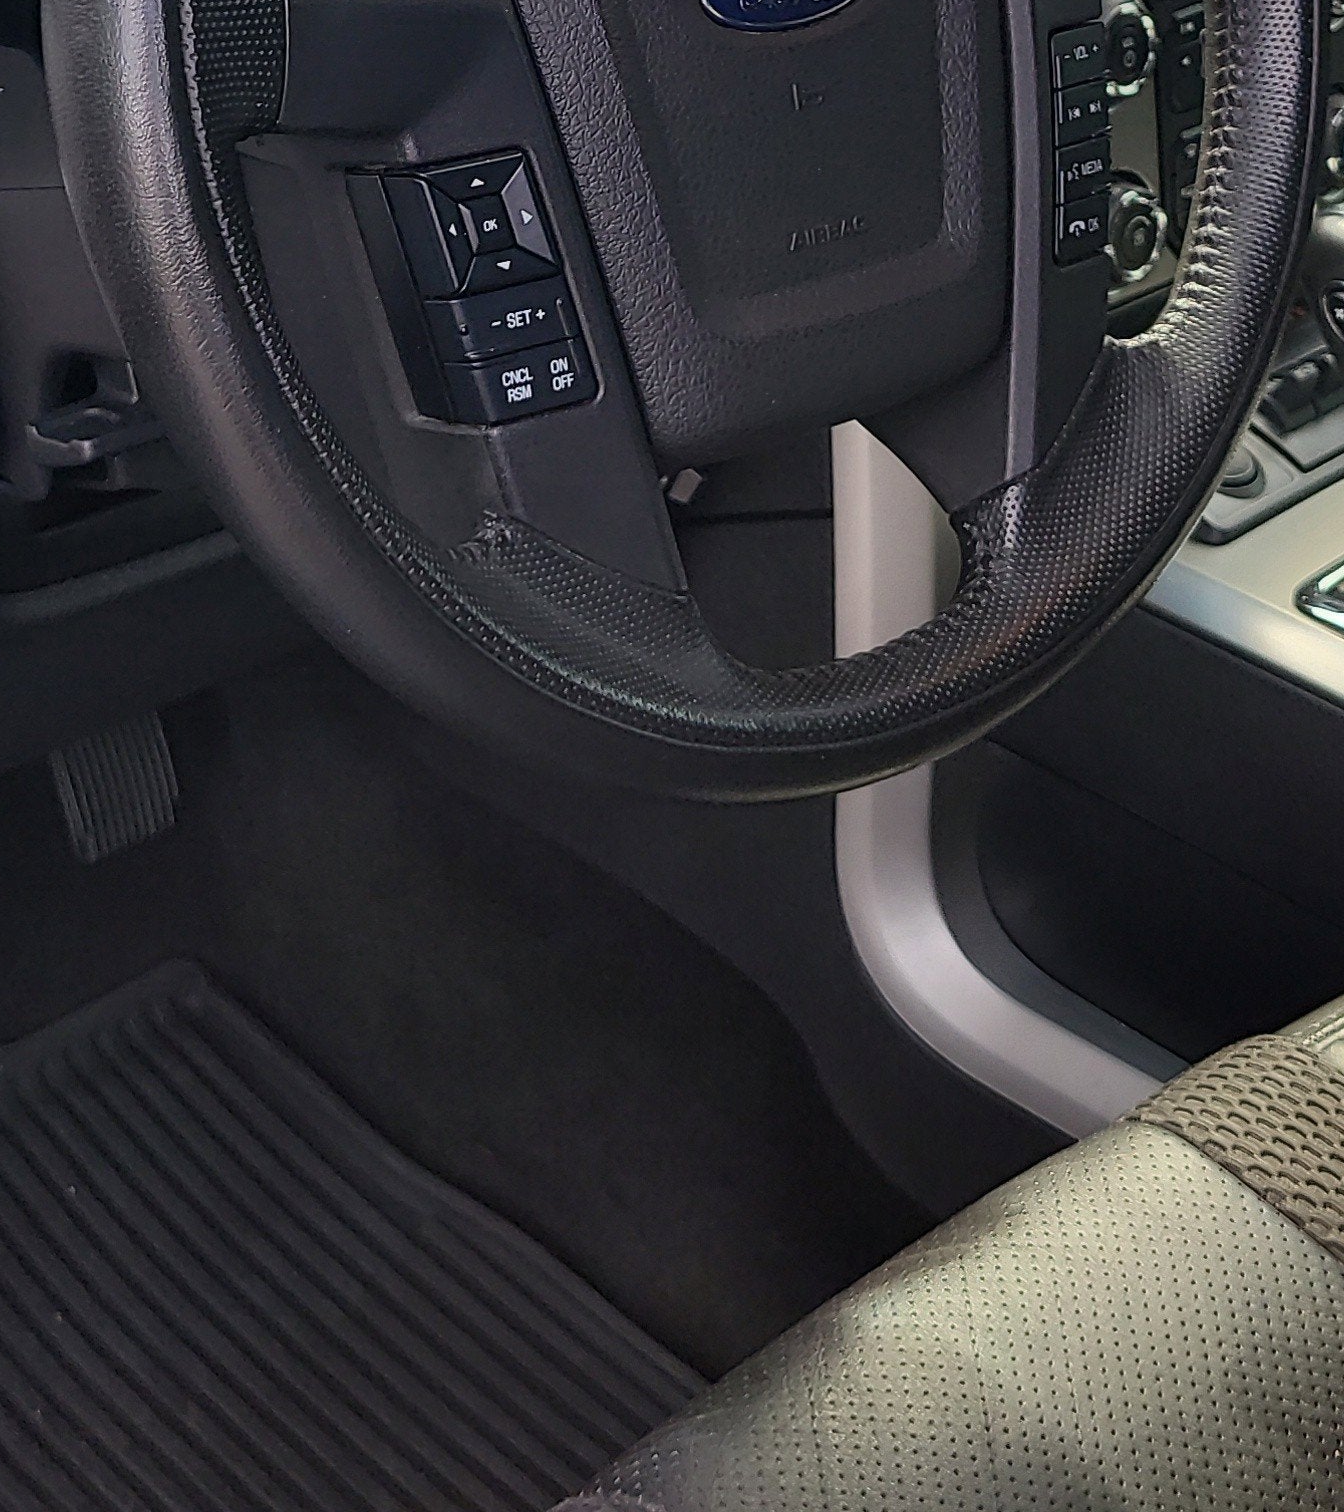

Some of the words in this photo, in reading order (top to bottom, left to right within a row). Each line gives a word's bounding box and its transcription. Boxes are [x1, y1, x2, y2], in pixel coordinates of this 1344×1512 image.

[483, 219, 498, 232] OK
[506, 309, 532, 329] SET
[550, 357, 569, 374] ON
[501, 367, 533, 387] CNCL
[552, 373, 574, 391] OFF
[507, 384, 532, 403] RSM
